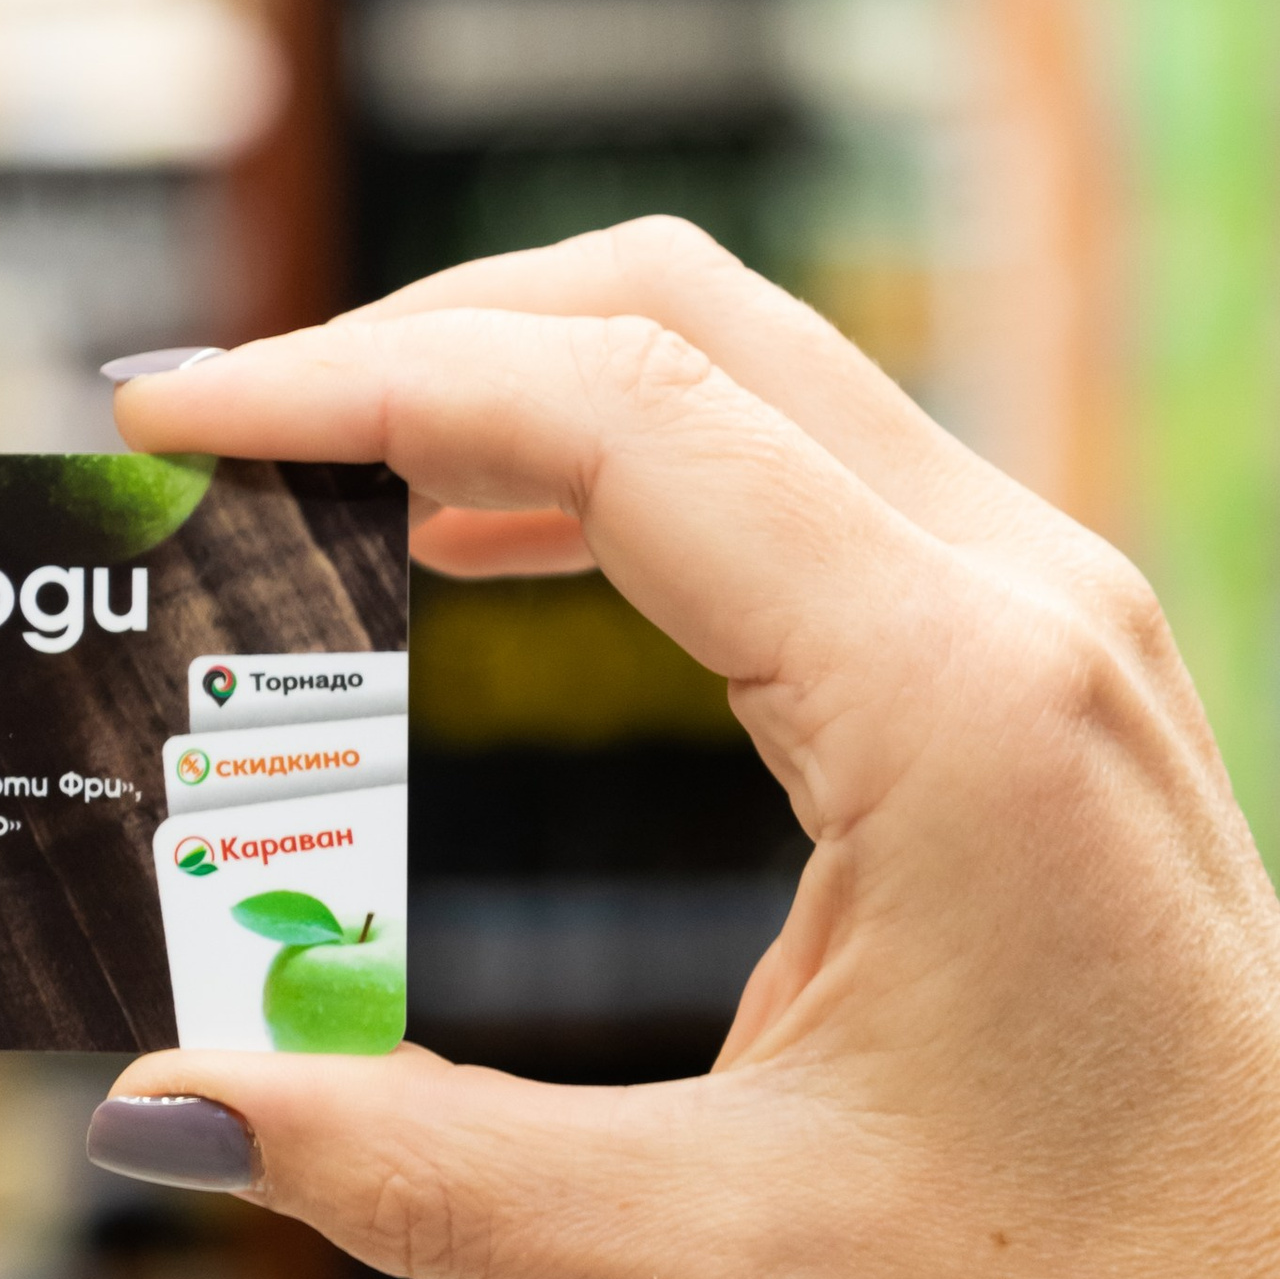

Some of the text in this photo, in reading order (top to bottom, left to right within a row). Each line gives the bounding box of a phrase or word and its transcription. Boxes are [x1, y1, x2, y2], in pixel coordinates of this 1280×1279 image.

[249, 672, 363, 695] Торнадо
[58, 770, 142, 804] Фри»,
[221, 828, 354, 865] Караван
